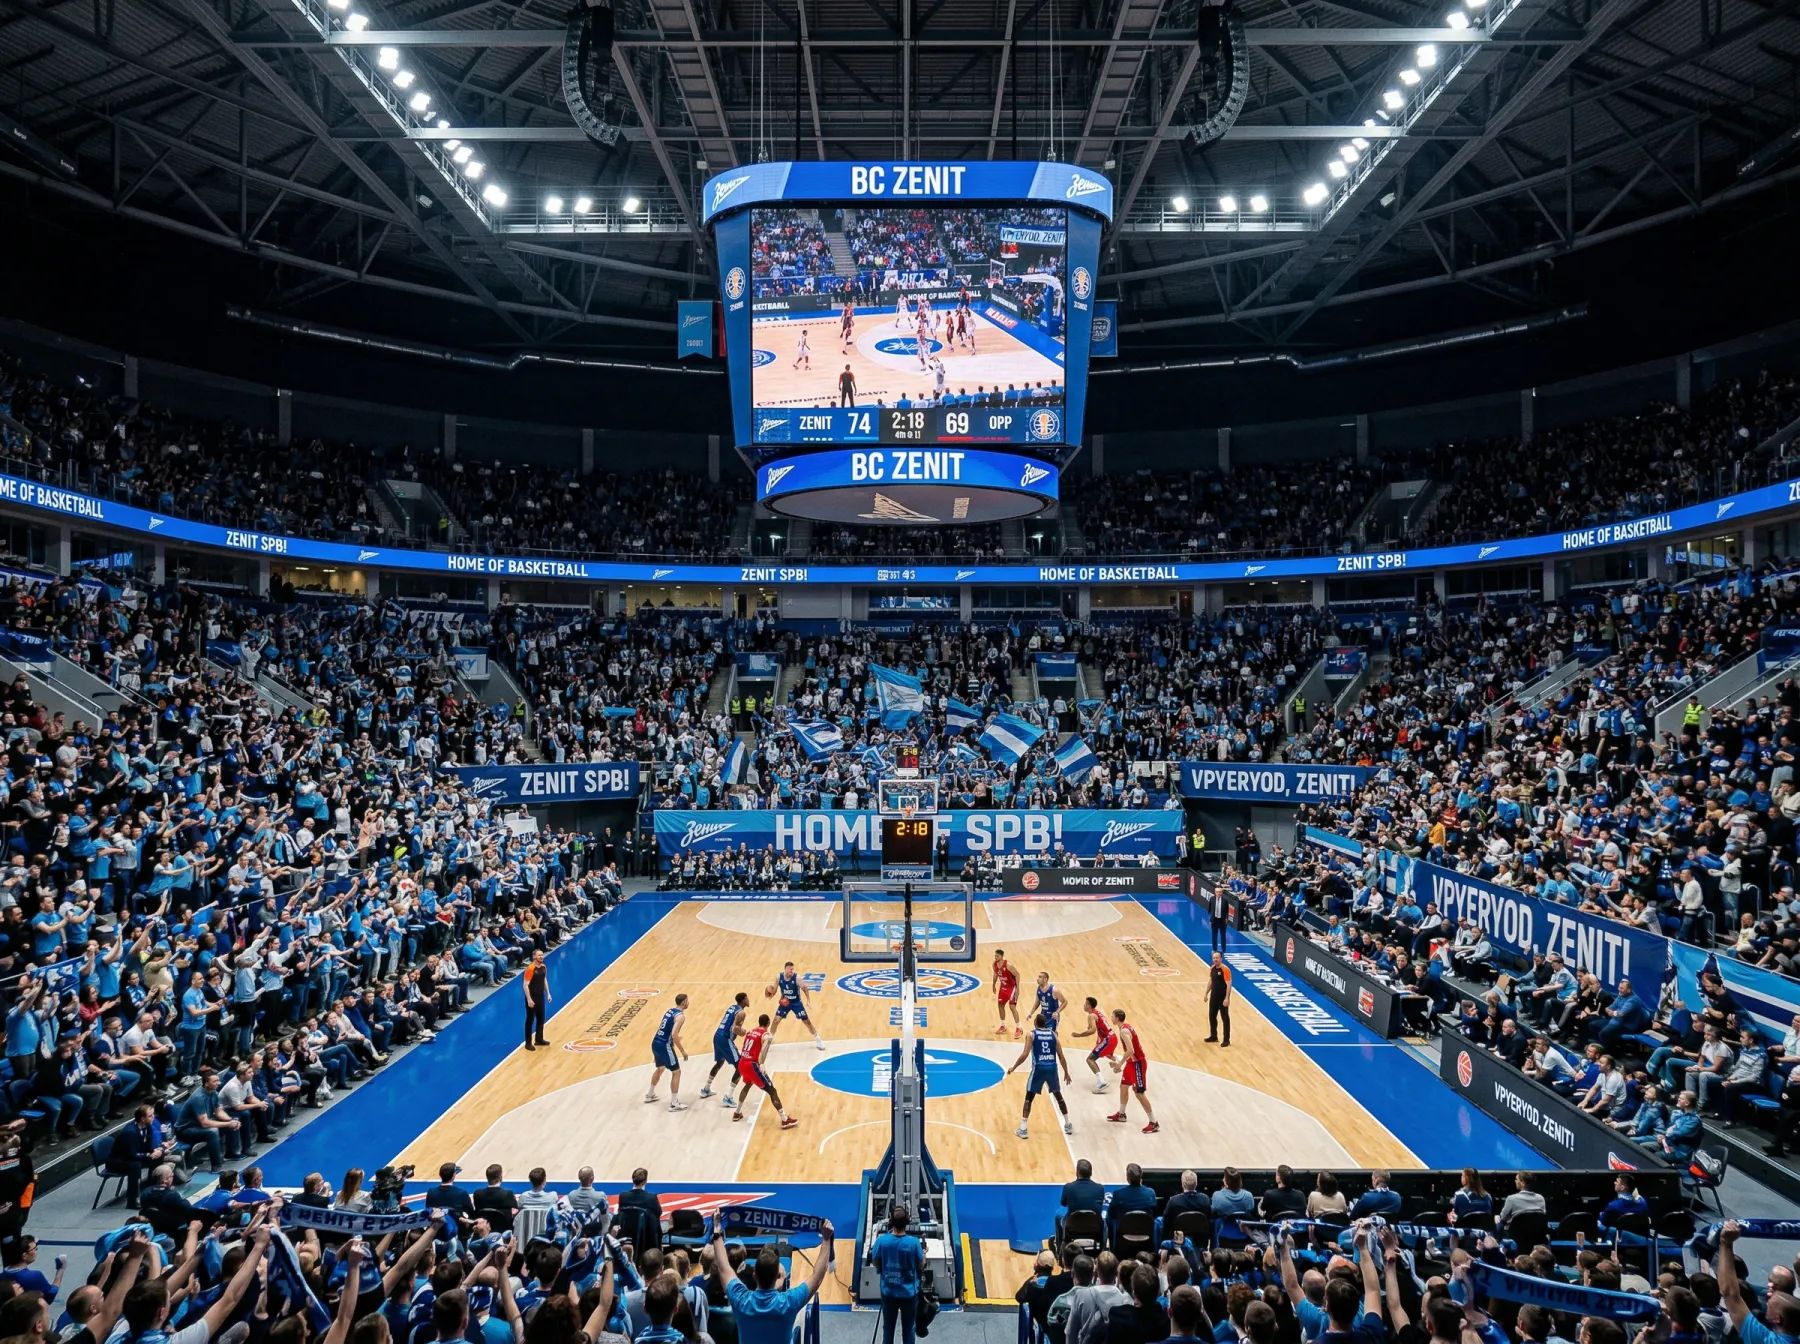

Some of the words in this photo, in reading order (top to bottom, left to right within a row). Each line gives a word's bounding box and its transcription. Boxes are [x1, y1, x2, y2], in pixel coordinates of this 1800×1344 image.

[852, 166, 885, 195] BC
[892, 166, 966, 195] ZENIT
[800, 416, 833, 430] ZENIT
[848, 413, 871, 434] 74
[892, 411, 925, 429] 2:18
[945, 412, 969, 434] 69
[989, 415, 1012, 430] OPP
[852, 452, 884, 481] BC
[891, 451, 965, 480] ZENIT
[20, 483, 35, 502] OF
[37, 487, 104, 519] BASKETBALL
[226, 531, 258, 549] ZENIT
[260, 537, 287, 554] SPB!
[1563, 531, 1595, 549] HOME
[1597, 528, 1611, 544] OF
[1613, 515, 1673, 541] BASKETBALL
[448, 556, 485, 571] HOME
[488, 558, 505, 573] OF
[508, 560, 589, 577] BASKETBALL
[1039, 567, 1076, 581] HOME
[1079, 567, 1095, 580] OF
[1098, 566, 1179, 580] BASKETBALL
[1337, 555, 1374, 571] ZENIT
[1377, 554, 1406, 568] SPB!
[741, 568, 776, 581] ZENIT
[779, 568, 808, 581] SPB!
[520, 771, 579, 796] ZENIT
[584, 769, 629, 793] SPB!
[1191, 769, 1290, 797] VPYERYOD,
[897, 821, 928, 836] 2:18
[966, 813, 1063, 851] SPB!
[1432, 874, 1539, 954] VPYERYOD,
[1547, 912, 1631, 987] ZENIT!
[1494, 1081, 1542, 1131] VPYERYOD,
[1542, 1114, 1575, 1152] ZENIT!
[744, 1211, 786, 1227] ZENIT
